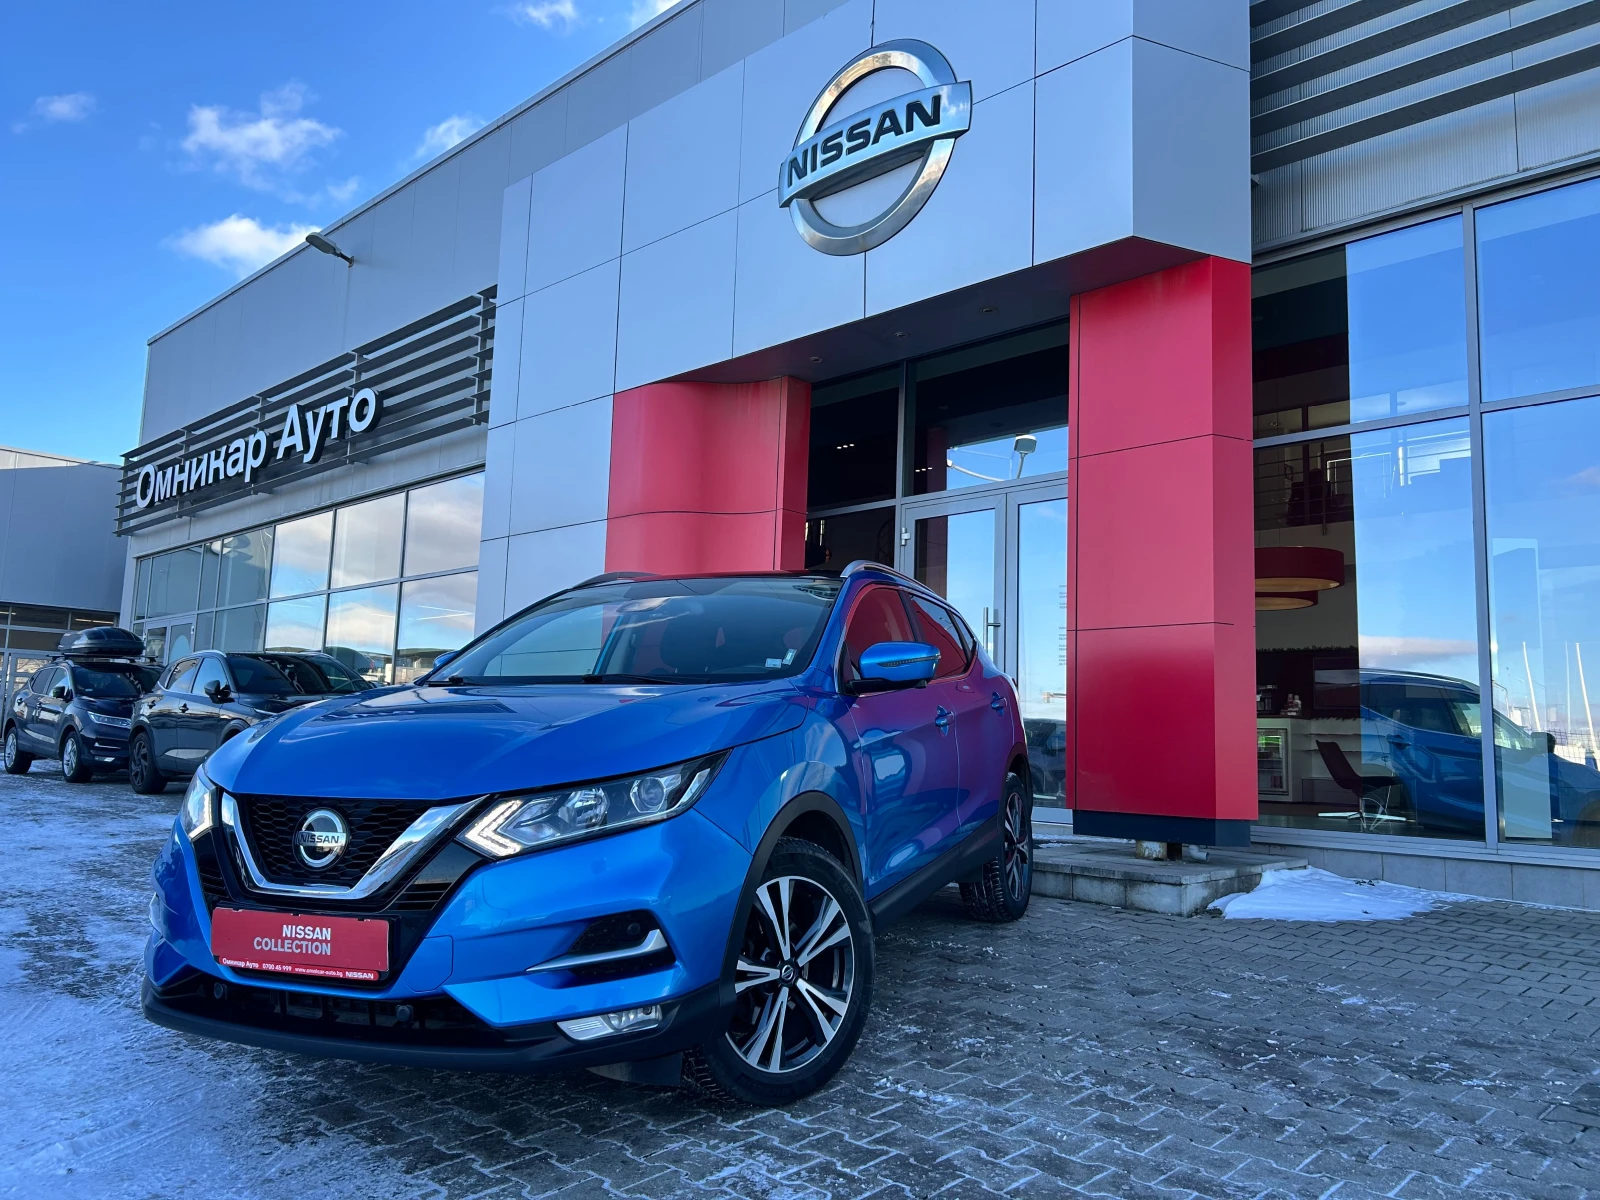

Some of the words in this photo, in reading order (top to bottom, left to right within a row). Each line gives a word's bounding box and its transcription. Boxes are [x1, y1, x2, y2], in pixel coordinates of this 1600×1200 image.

[787, 94, 942, 189] NISSAN
[136, 430, 270, 509] Омникар
[276, 387, 377, 464] Ауто
[300, 834, 339, 844] NISSAN
[282, 925, 331, 940] NISSAN
[253, 937, 331, 955] COLLECTION
[345, 971, 374, 979] NISSAN
